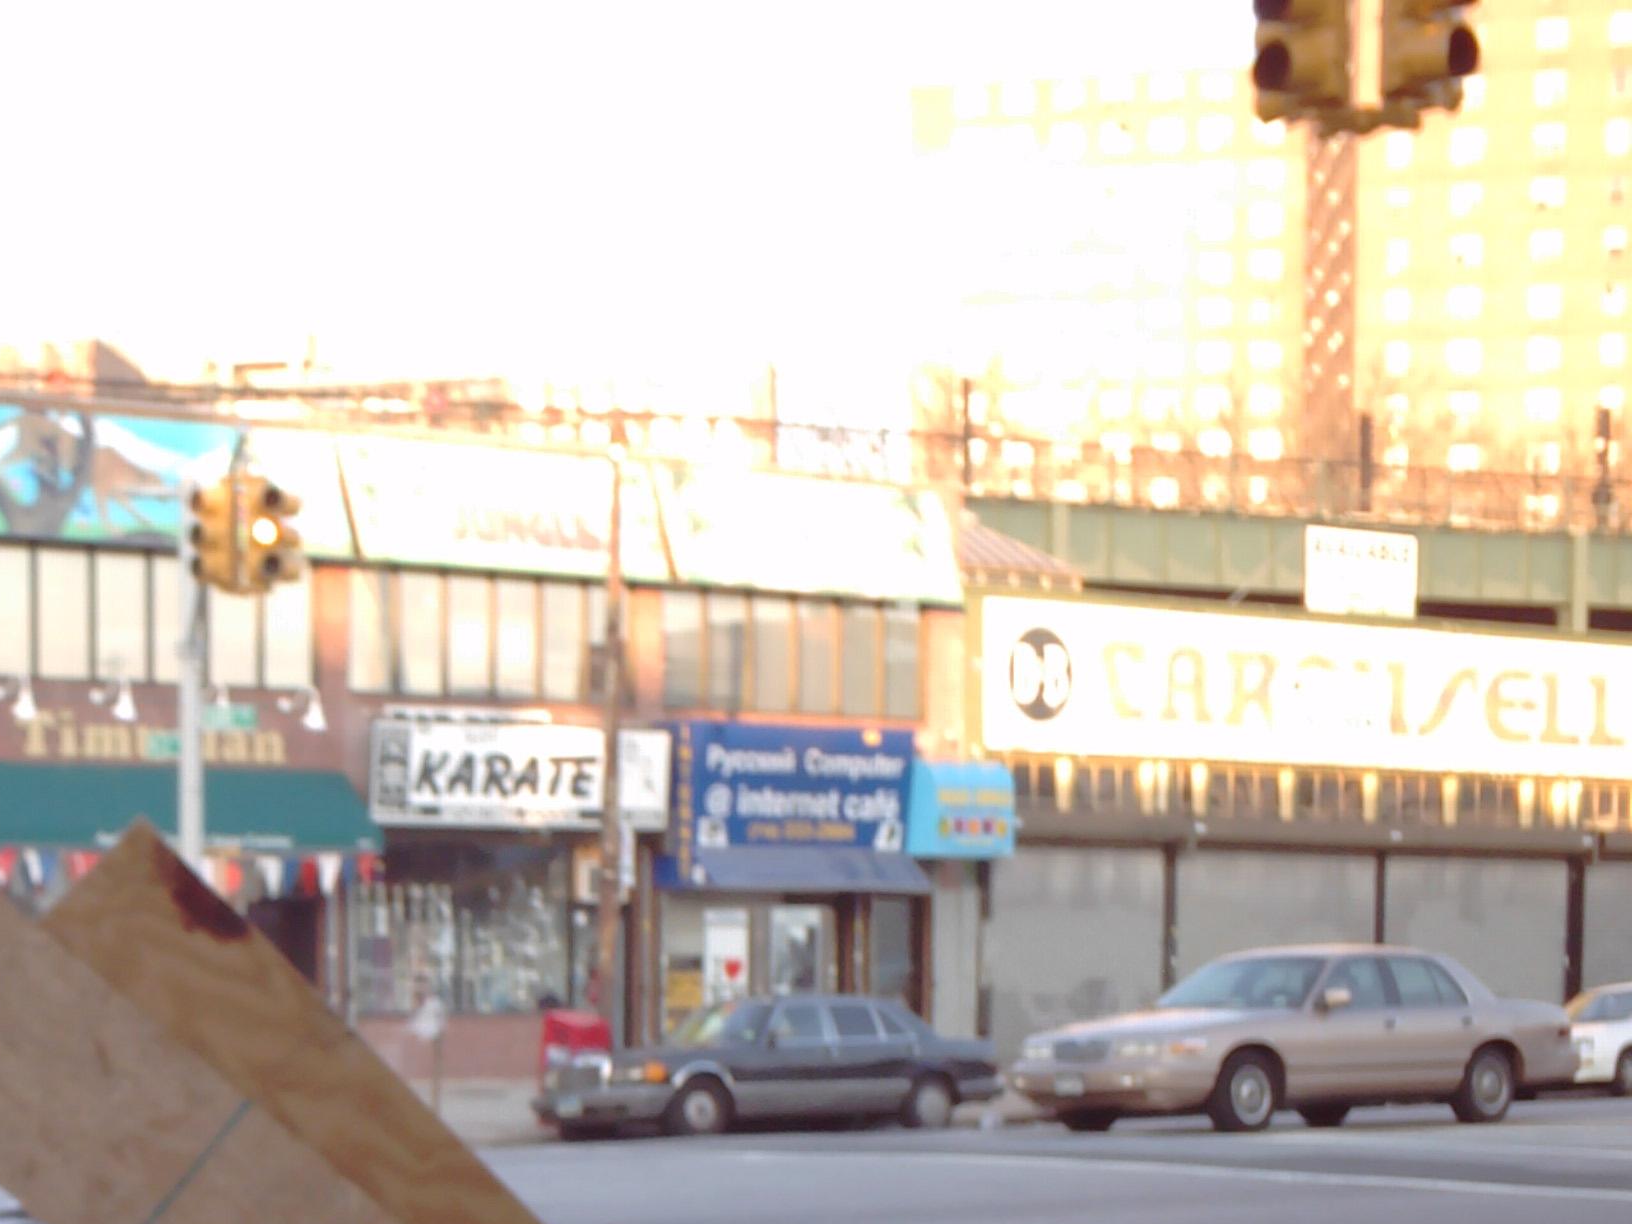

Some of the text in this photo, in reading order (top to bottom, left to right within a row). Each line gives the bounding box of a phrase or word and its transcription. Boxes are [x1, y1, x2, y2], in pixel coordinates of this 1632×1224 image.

[1101, 640, 1630, 748] CARUSELL
[415, 749, 599, 799] KARATE
[803, 746, 905, 782] Computer
